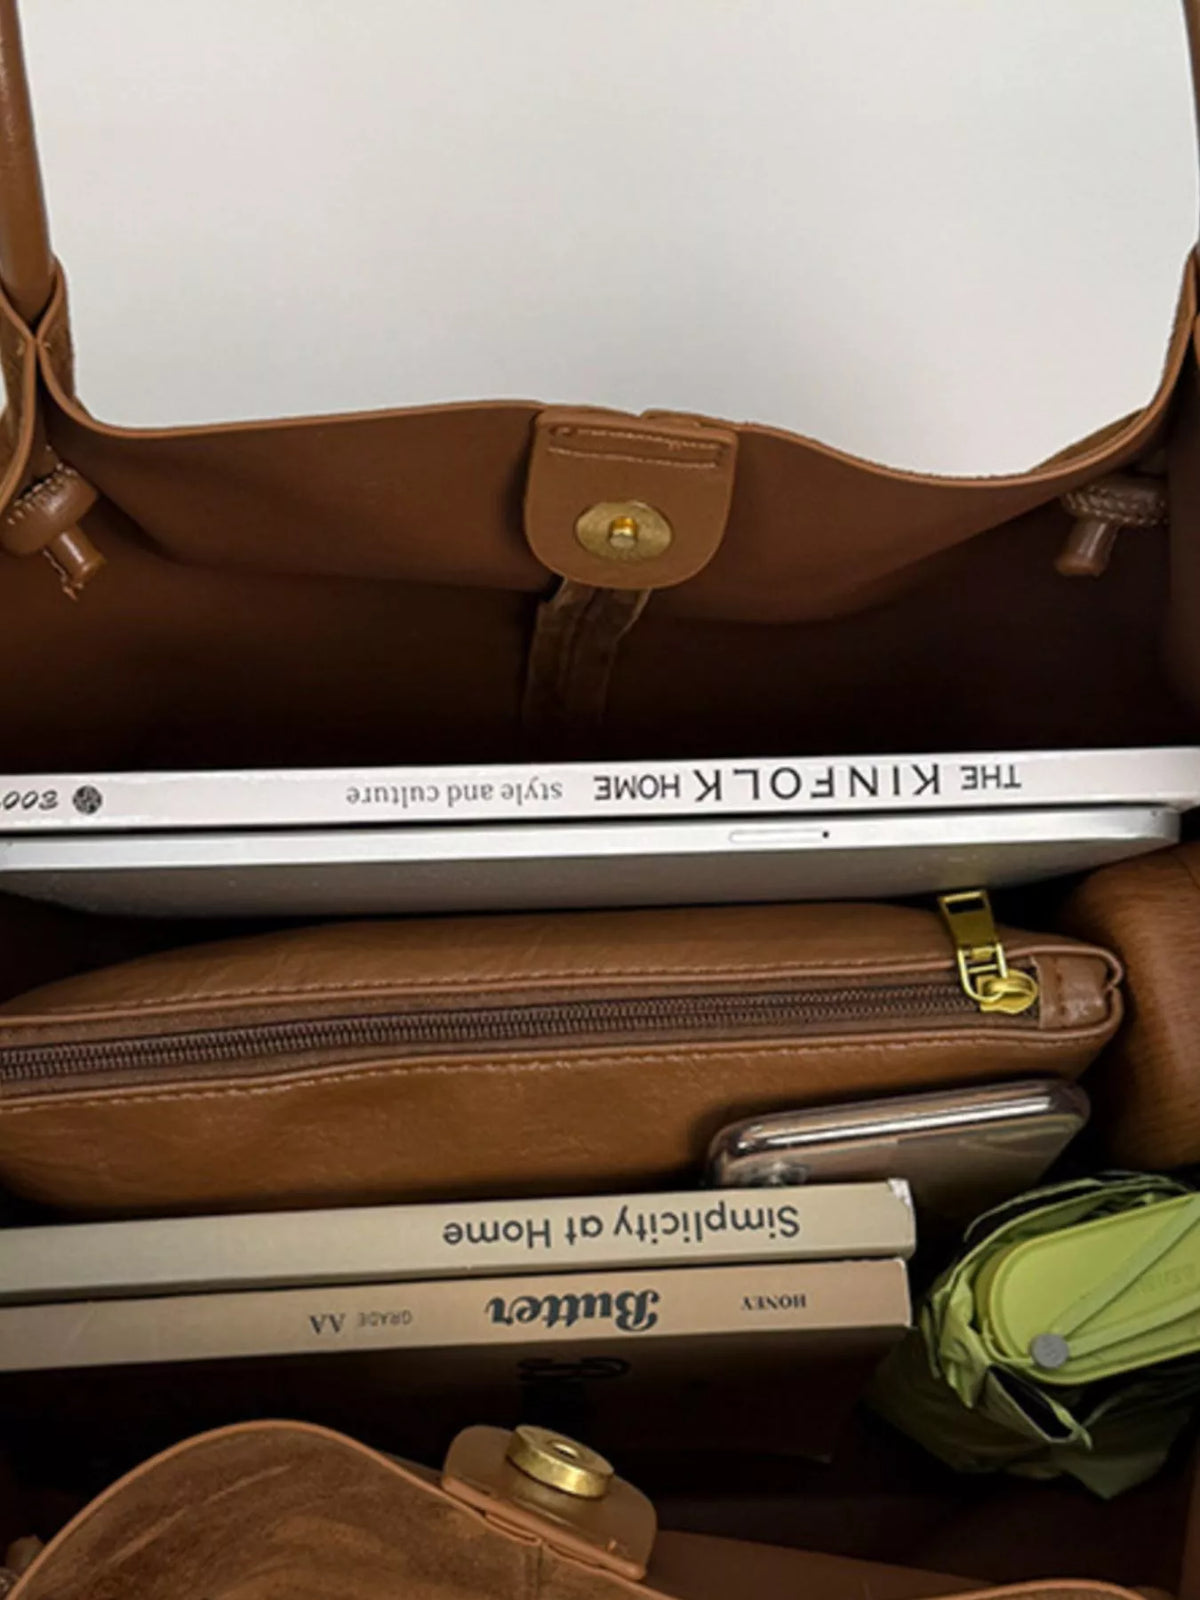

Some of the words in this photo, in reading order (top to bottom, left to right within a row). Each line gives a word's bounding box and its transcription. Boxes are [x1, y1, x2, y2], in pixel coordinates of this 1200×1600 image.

[593, 773, 682, 802] HOME
[692, 762, 941, 804] KINFOLK
[958, 764, 1022, 791] THE
[346, 784, 441, 809] culture
[446, 782, 495, 809] and
[500, 777, 564, 808] style
[442, 1218, 552, 1250] Home
[564, 1213, 604, 1246] at
[613, 1201, 800, 1243] Simplicity
[484, 1289, 661, 1333] Butter
[742, 1294, 807, 1311] HONEY
[309, 1314, 345, 1335] AA
[358, 1310, 413, 1327] GRADE
